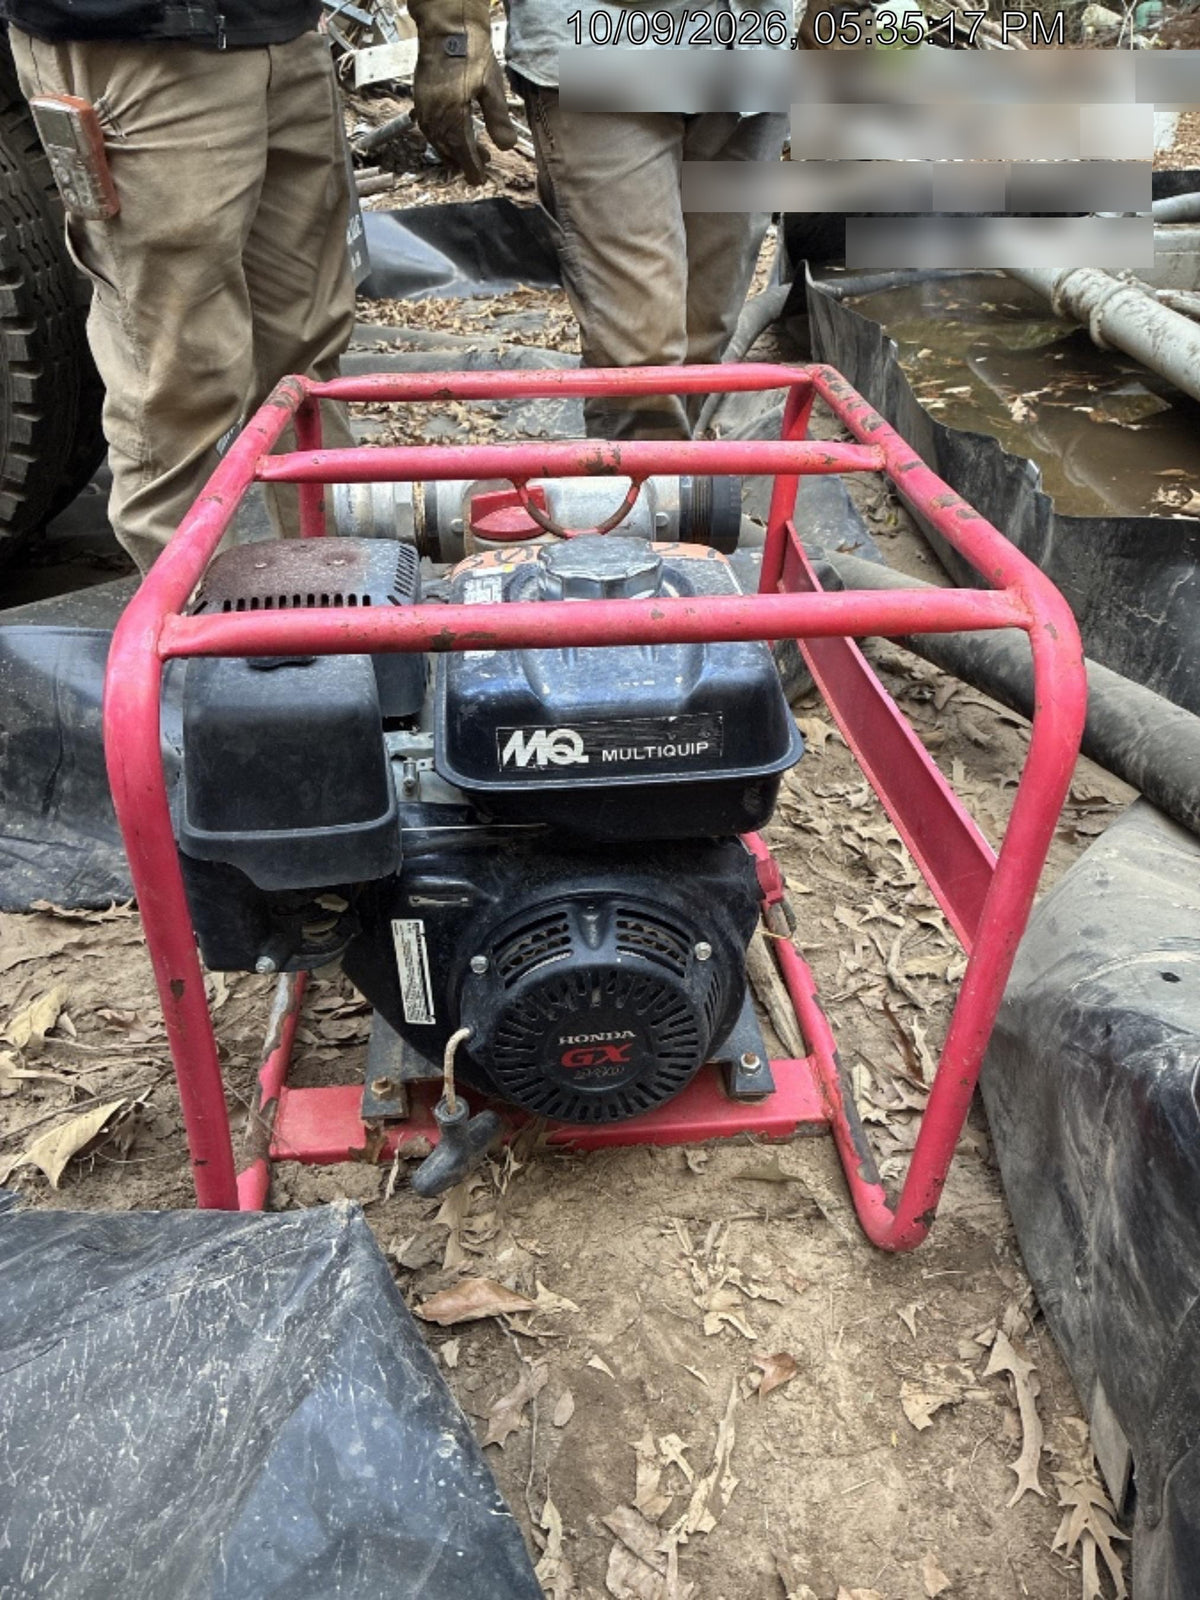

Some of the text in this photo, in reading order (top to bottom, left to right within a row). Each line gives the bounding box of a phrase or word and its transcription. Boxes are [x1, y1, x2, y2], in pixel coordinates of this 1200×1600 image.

[502, 728, 710, 767] MQ MULTIQUIP
[559, 1030, 636, 1045] HONDA
[561, 1042, 634, 1067] GX
